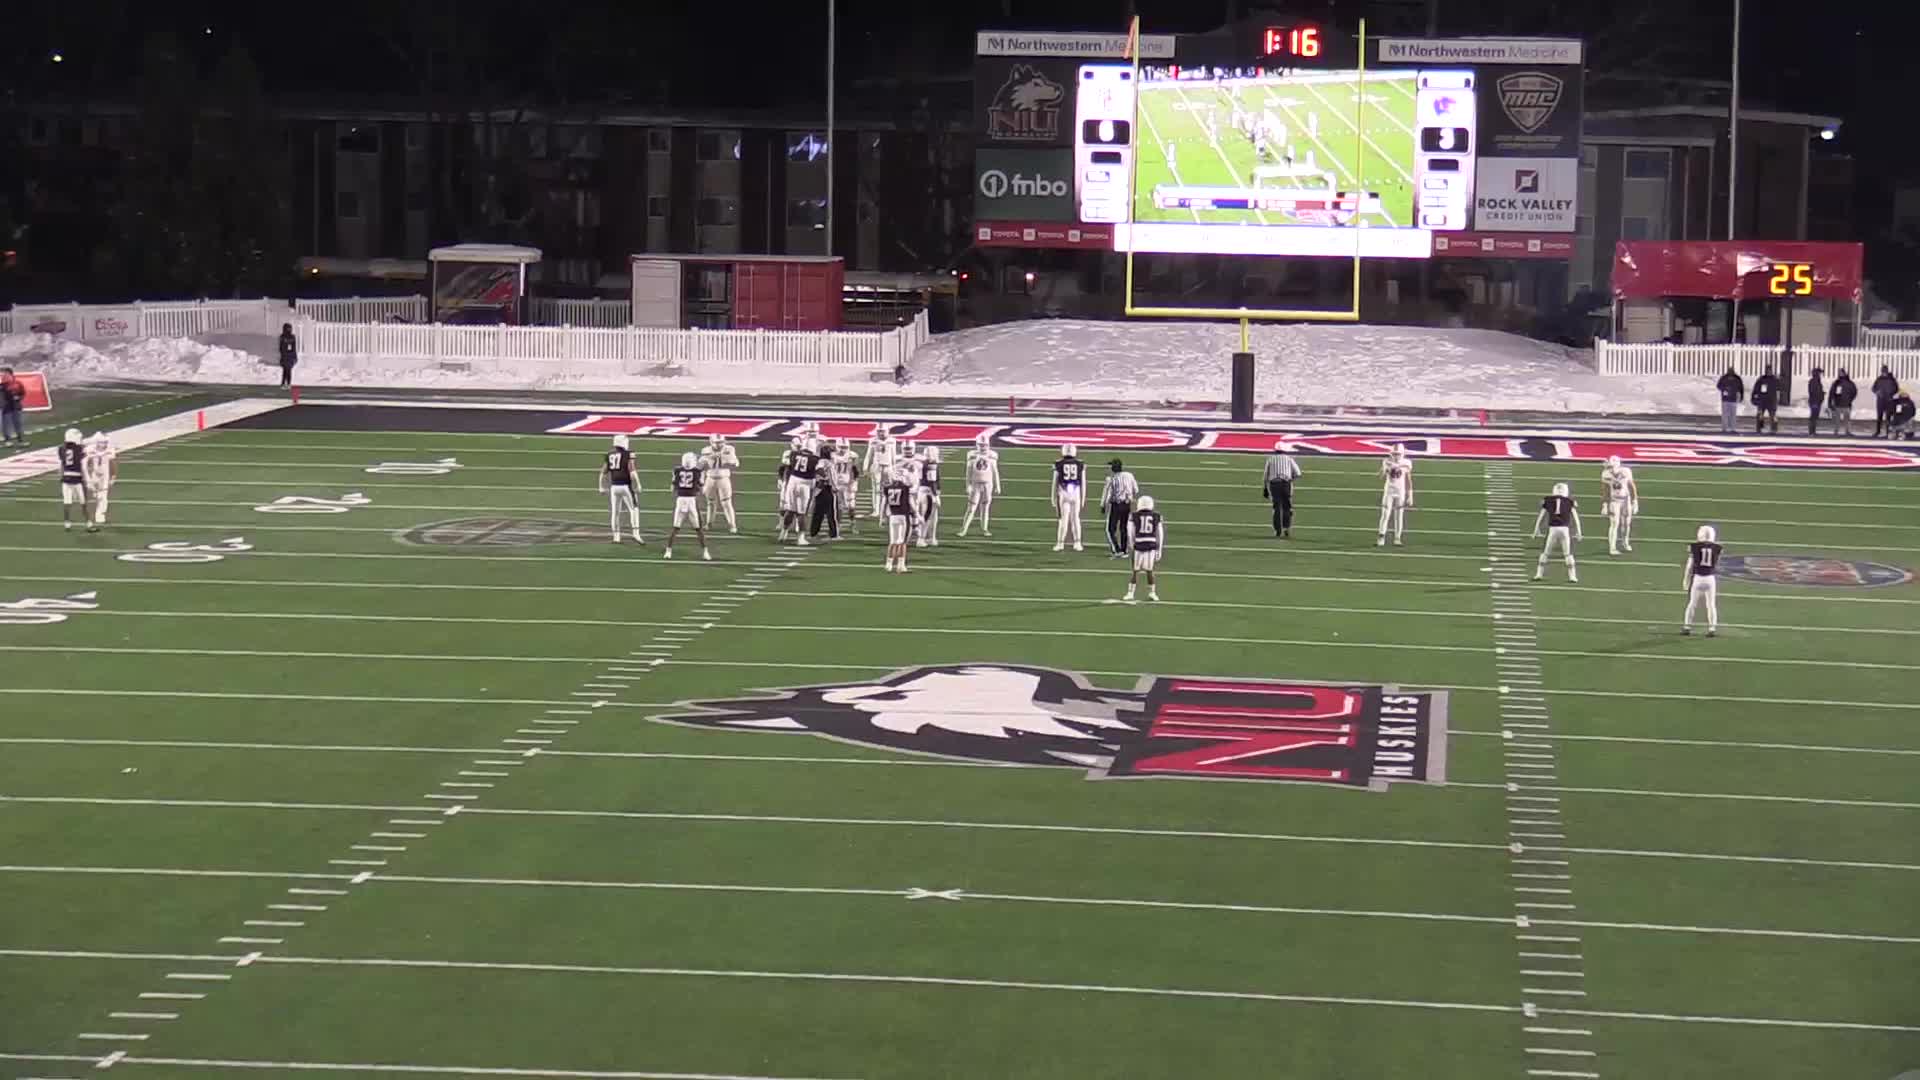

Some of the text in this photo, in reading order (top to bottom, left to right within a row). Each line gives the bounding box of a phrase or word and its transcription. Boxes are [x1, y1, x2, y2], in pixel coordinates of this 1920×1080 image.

[1007, 38, 1101, 52] Northwestern
[1266, 29, 1318, 56] 1:16
[1409, 44, 1505, 58] Northwestern
[991, 110, 1057, 130] NIU
[1478, 198, 1572, 210] ROCK VALLEY
[1486, 212, 1563, 222] CREDIT UNION
[1770, 264, 1813, 294] 25
[65, 449, 74, 466] 2
[608, 452, 622, 469] 97
[794, 455, 808, 473] 79
[678, 471, 693, 488] 32
[1063, 463, 1078, 480] 99
[888, 488, 902, 506] 27
[1555, 498, 1562, 515] 1
[1139, 515, 1153, 534] 16
[1701, 548, 1713, 567] 11
[1130, 681, 1363, 781] NIU
[1373, 696, 1420, 776] HUSKIES
